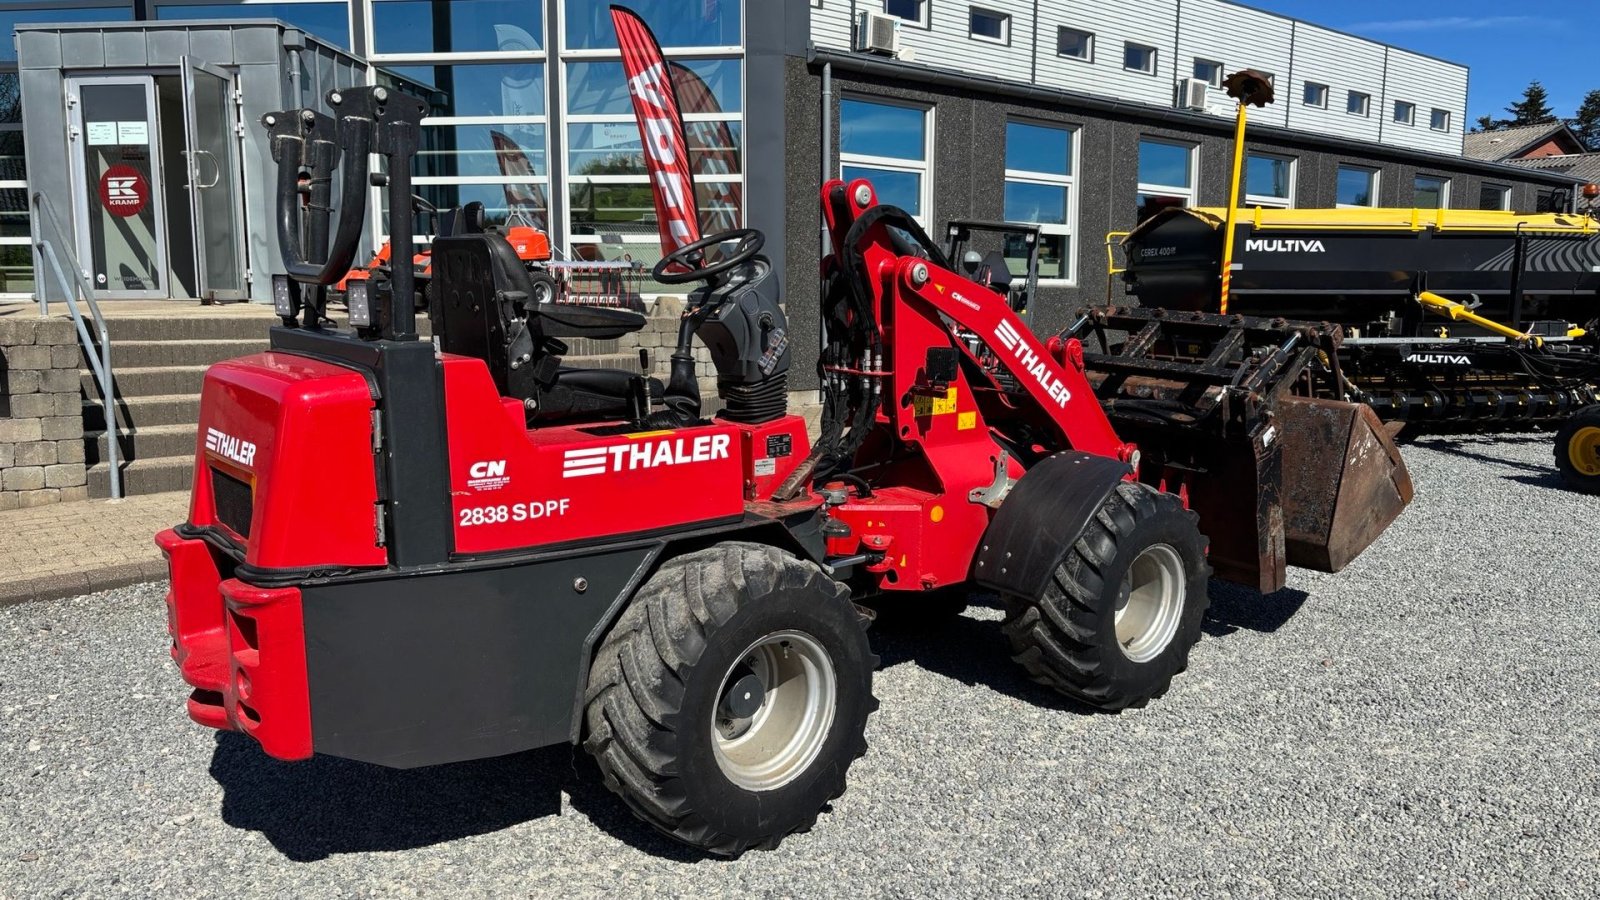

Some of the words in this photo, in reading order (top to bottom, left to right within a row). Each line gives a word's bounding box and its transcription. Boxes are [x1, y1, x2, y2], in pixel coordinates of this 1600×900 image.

[1140, 247, 1159, 257] CEREX
[1245, 239, 1326, 253] MULTIVA
[1403, 354, 1472, 365] MULTIVA
[1014, 338, 1071, 409] THALER
[216, 431, 257, 467] THALER
[608, 434, 731, 472] THALER
[469, 460, 506, 478] CN
[459, 505, 509, 527] 2838
